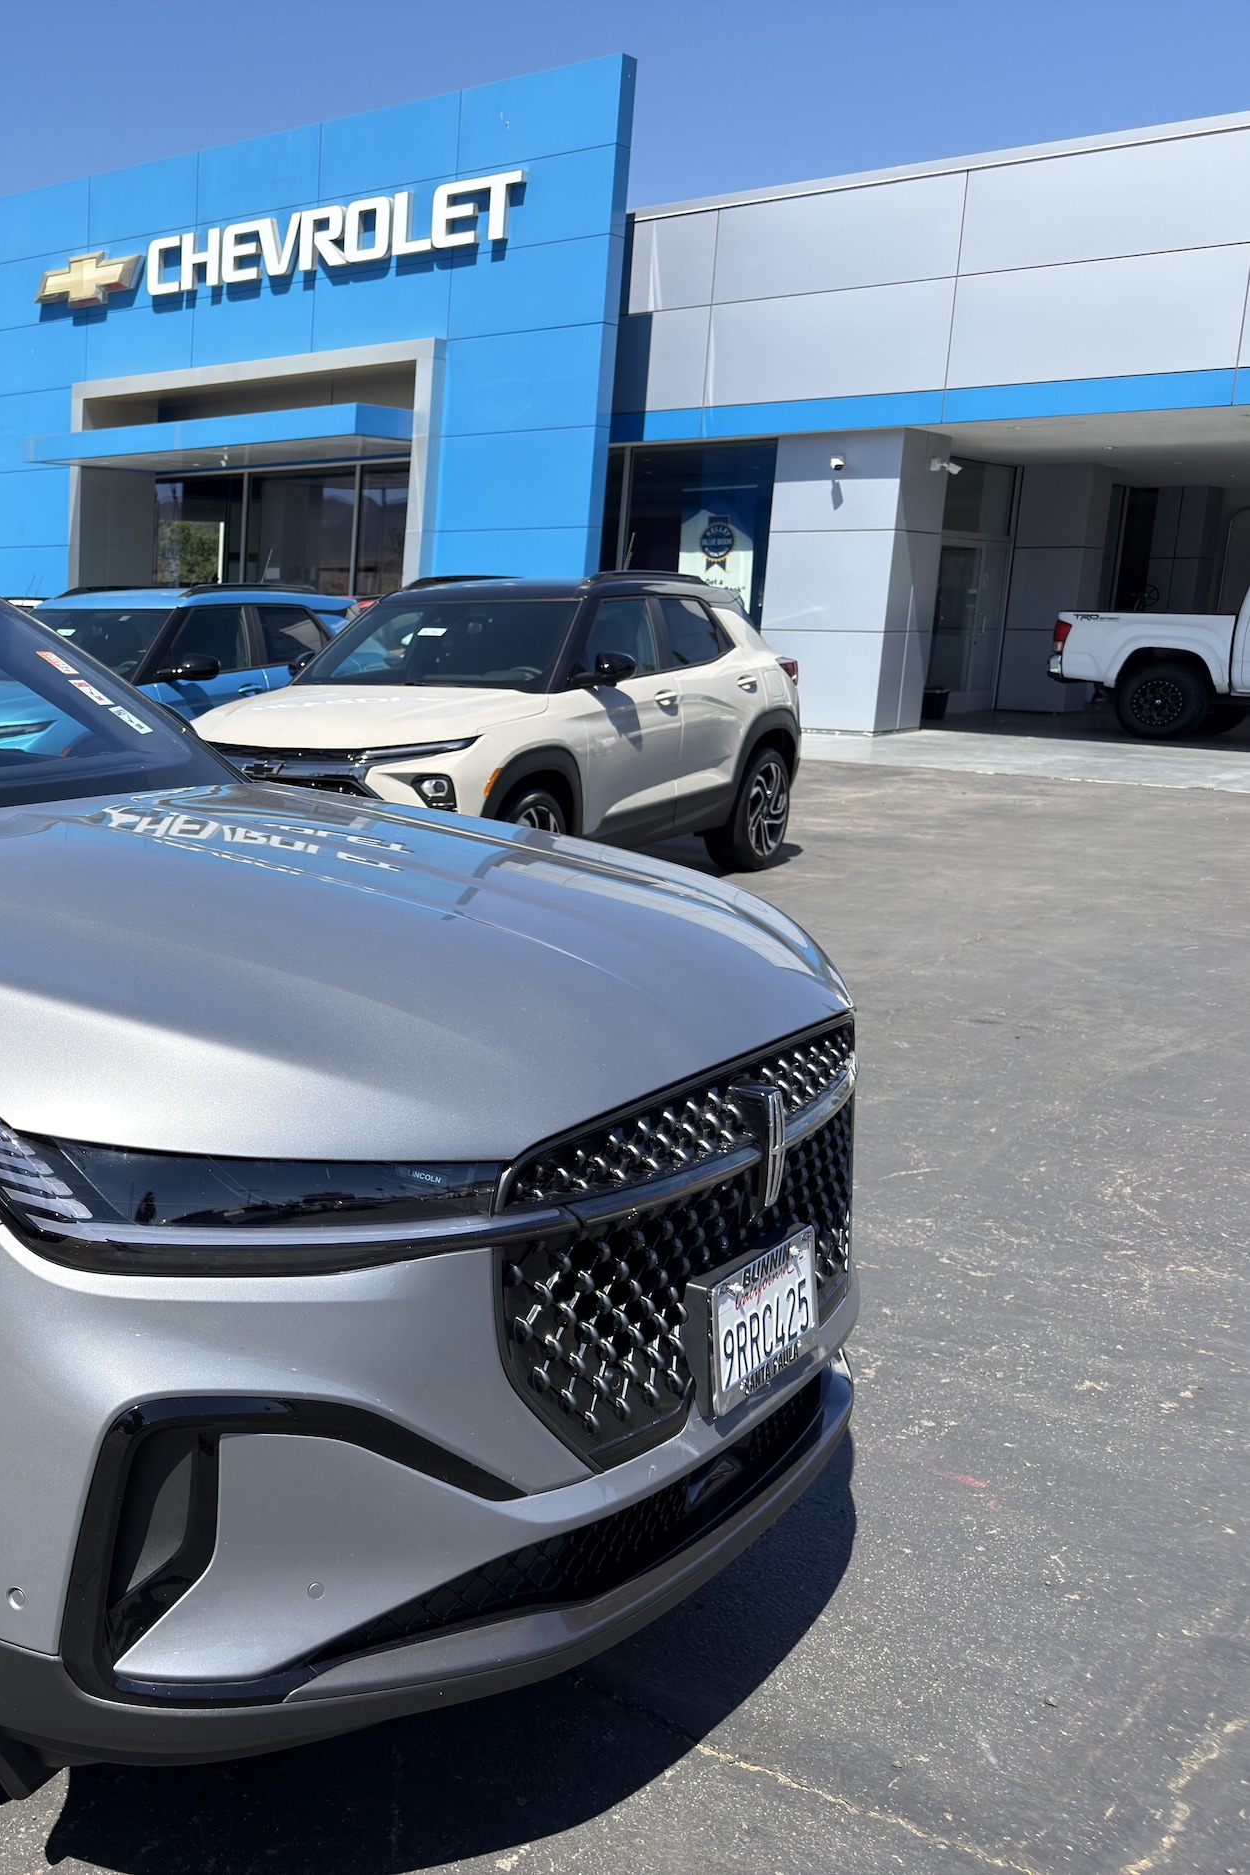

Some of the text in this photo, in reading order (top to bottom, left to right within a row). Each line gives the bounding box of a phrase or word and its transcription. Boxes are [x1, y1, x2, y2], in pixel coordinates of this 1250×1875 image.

[147, 169, 527, 296] CHEVROLET
[702, 538, 733, 546] BLUE BOOK
[742, 1242, 791, 1289] BUNNIN
[723, 1278, 809, 1392] 9RRC425
